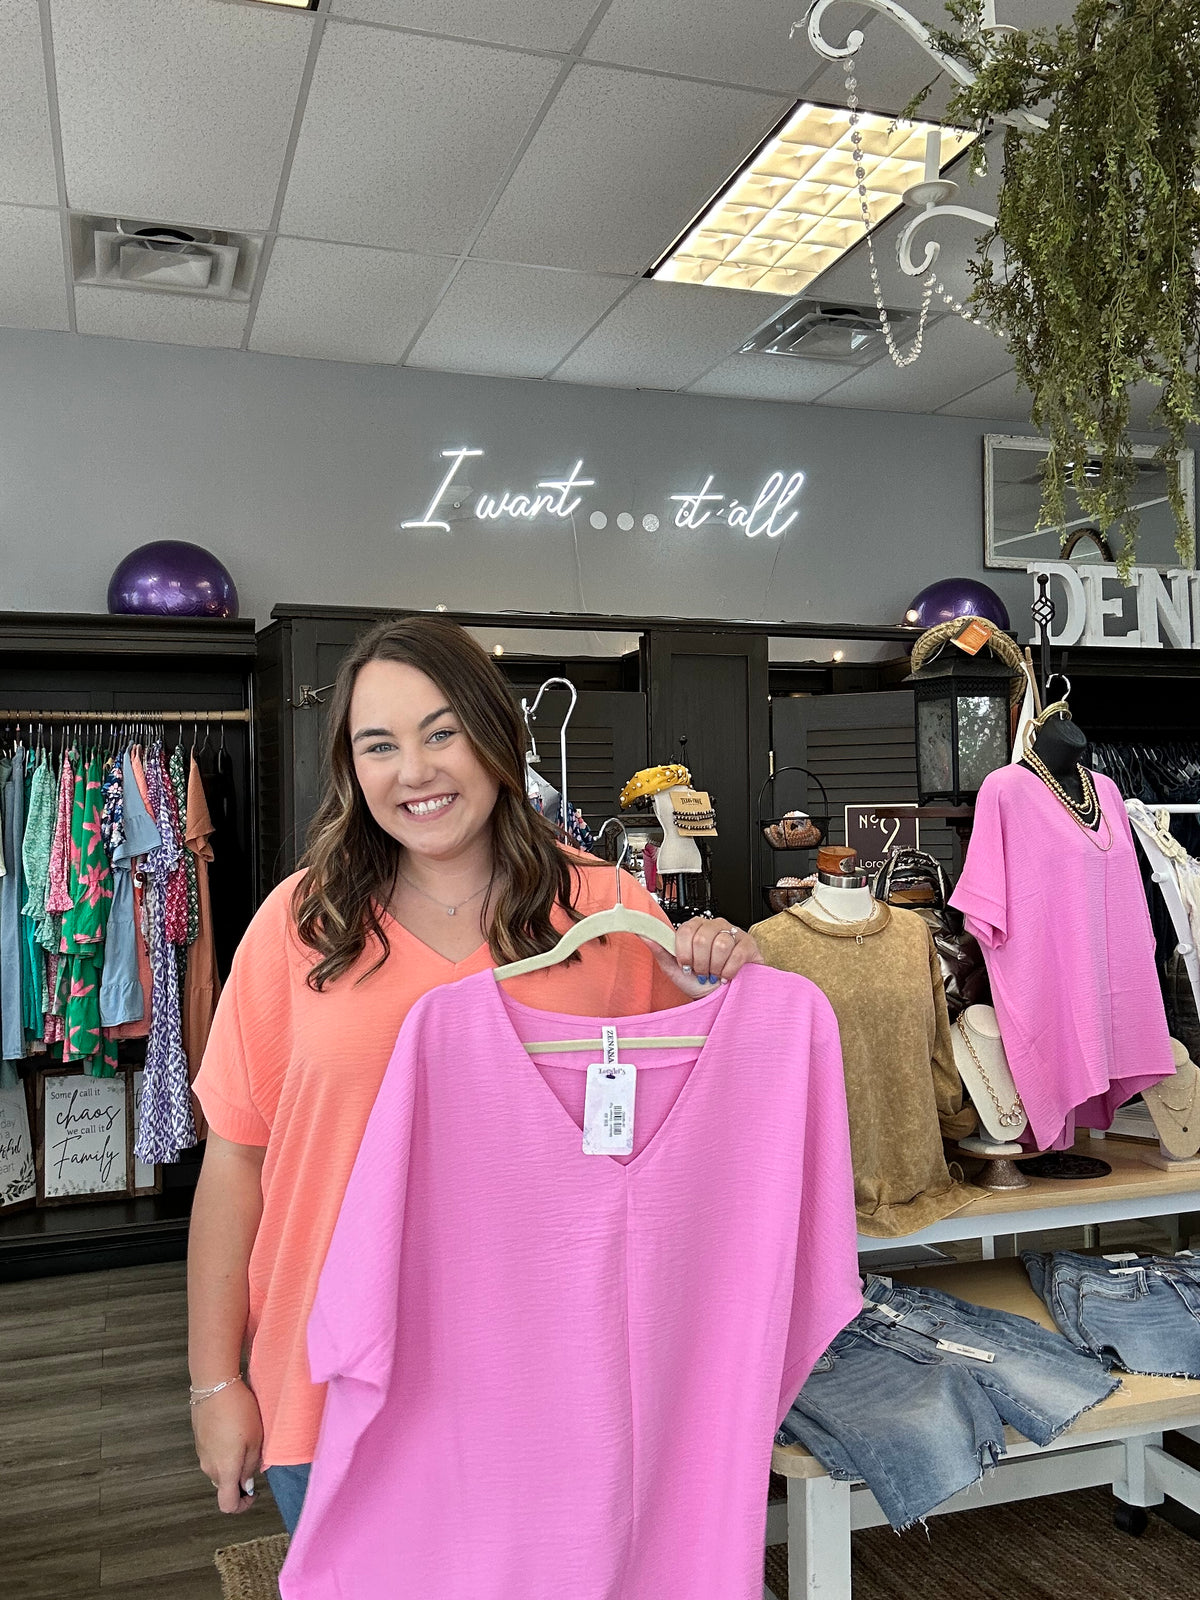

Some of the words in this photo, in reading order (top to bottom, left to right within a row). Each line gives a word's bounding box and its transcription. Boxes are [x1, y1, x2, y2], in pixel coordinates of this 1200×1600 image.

[401, 447, 483, 532] I
[475, 460, 595, 519] want
[670, 475, 725, 529] it
[727, 472, 805, 537] all
[606, 1029, 616, 1064] ZENANA
[50, 1091, 72, 1100] Some
[80, 1088, 93, 1097] call
[94, 1087, 101, 1096] it
[56, 1089, 122, 1130] chaos
[66, 1128, 79, 1136] we
[80, 1125, 96, 1135] call
[98, 1124, 105, 1133] it
[52, 1135, 120, 1184] Family
